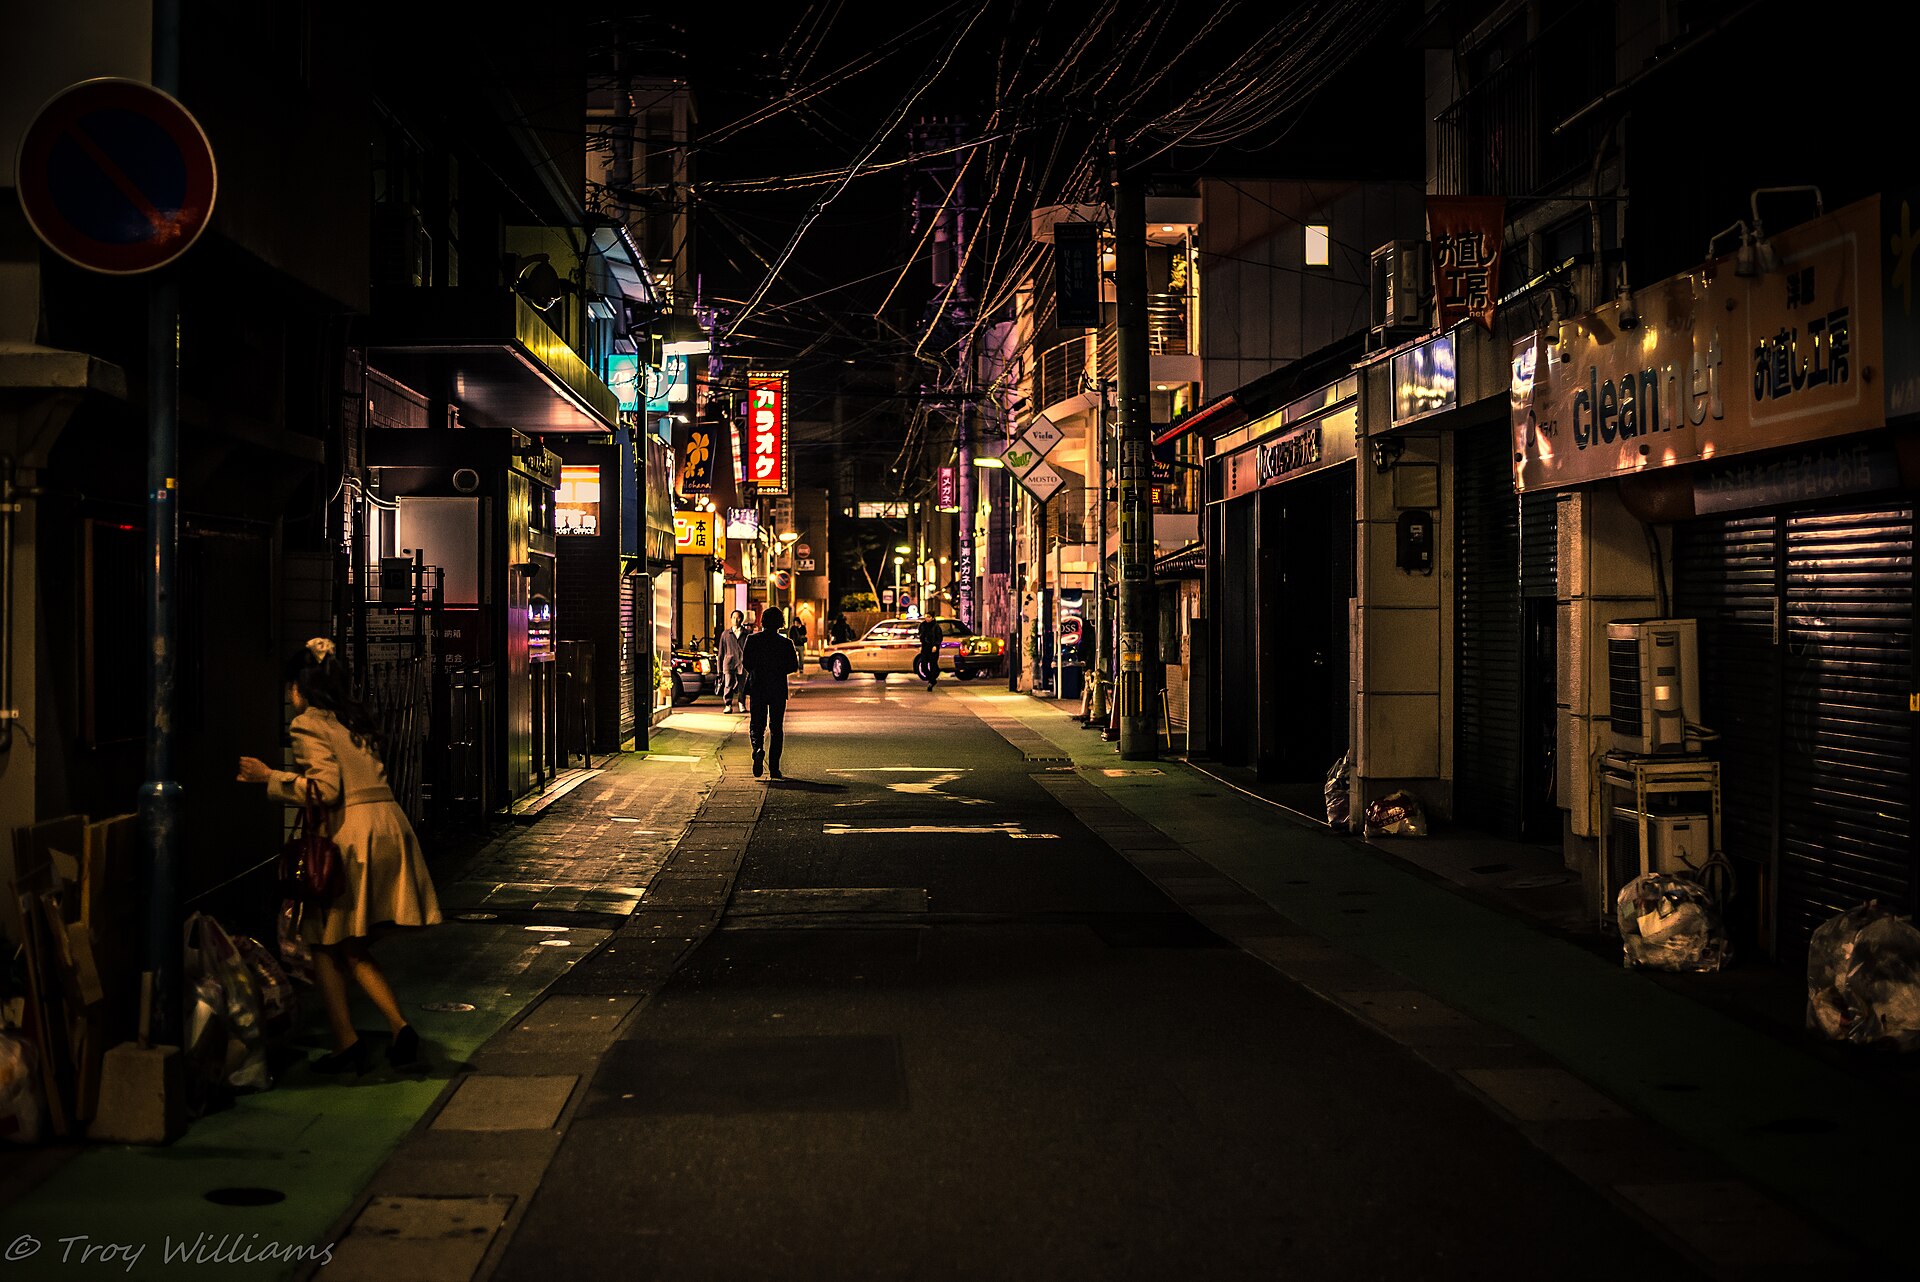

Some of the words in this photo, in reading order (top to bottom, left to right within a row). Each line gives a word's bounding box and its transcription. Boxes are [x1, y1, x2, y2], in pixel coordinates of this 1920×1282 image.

[1445, 268, 1489, 308] 工房
[1754, 306, 1850, 401] お直し工房
[755, 387, 775, 478] カラオケ
[573, 527, 595, 535] OFFICE
[695, 519, 707, 547] 本店
